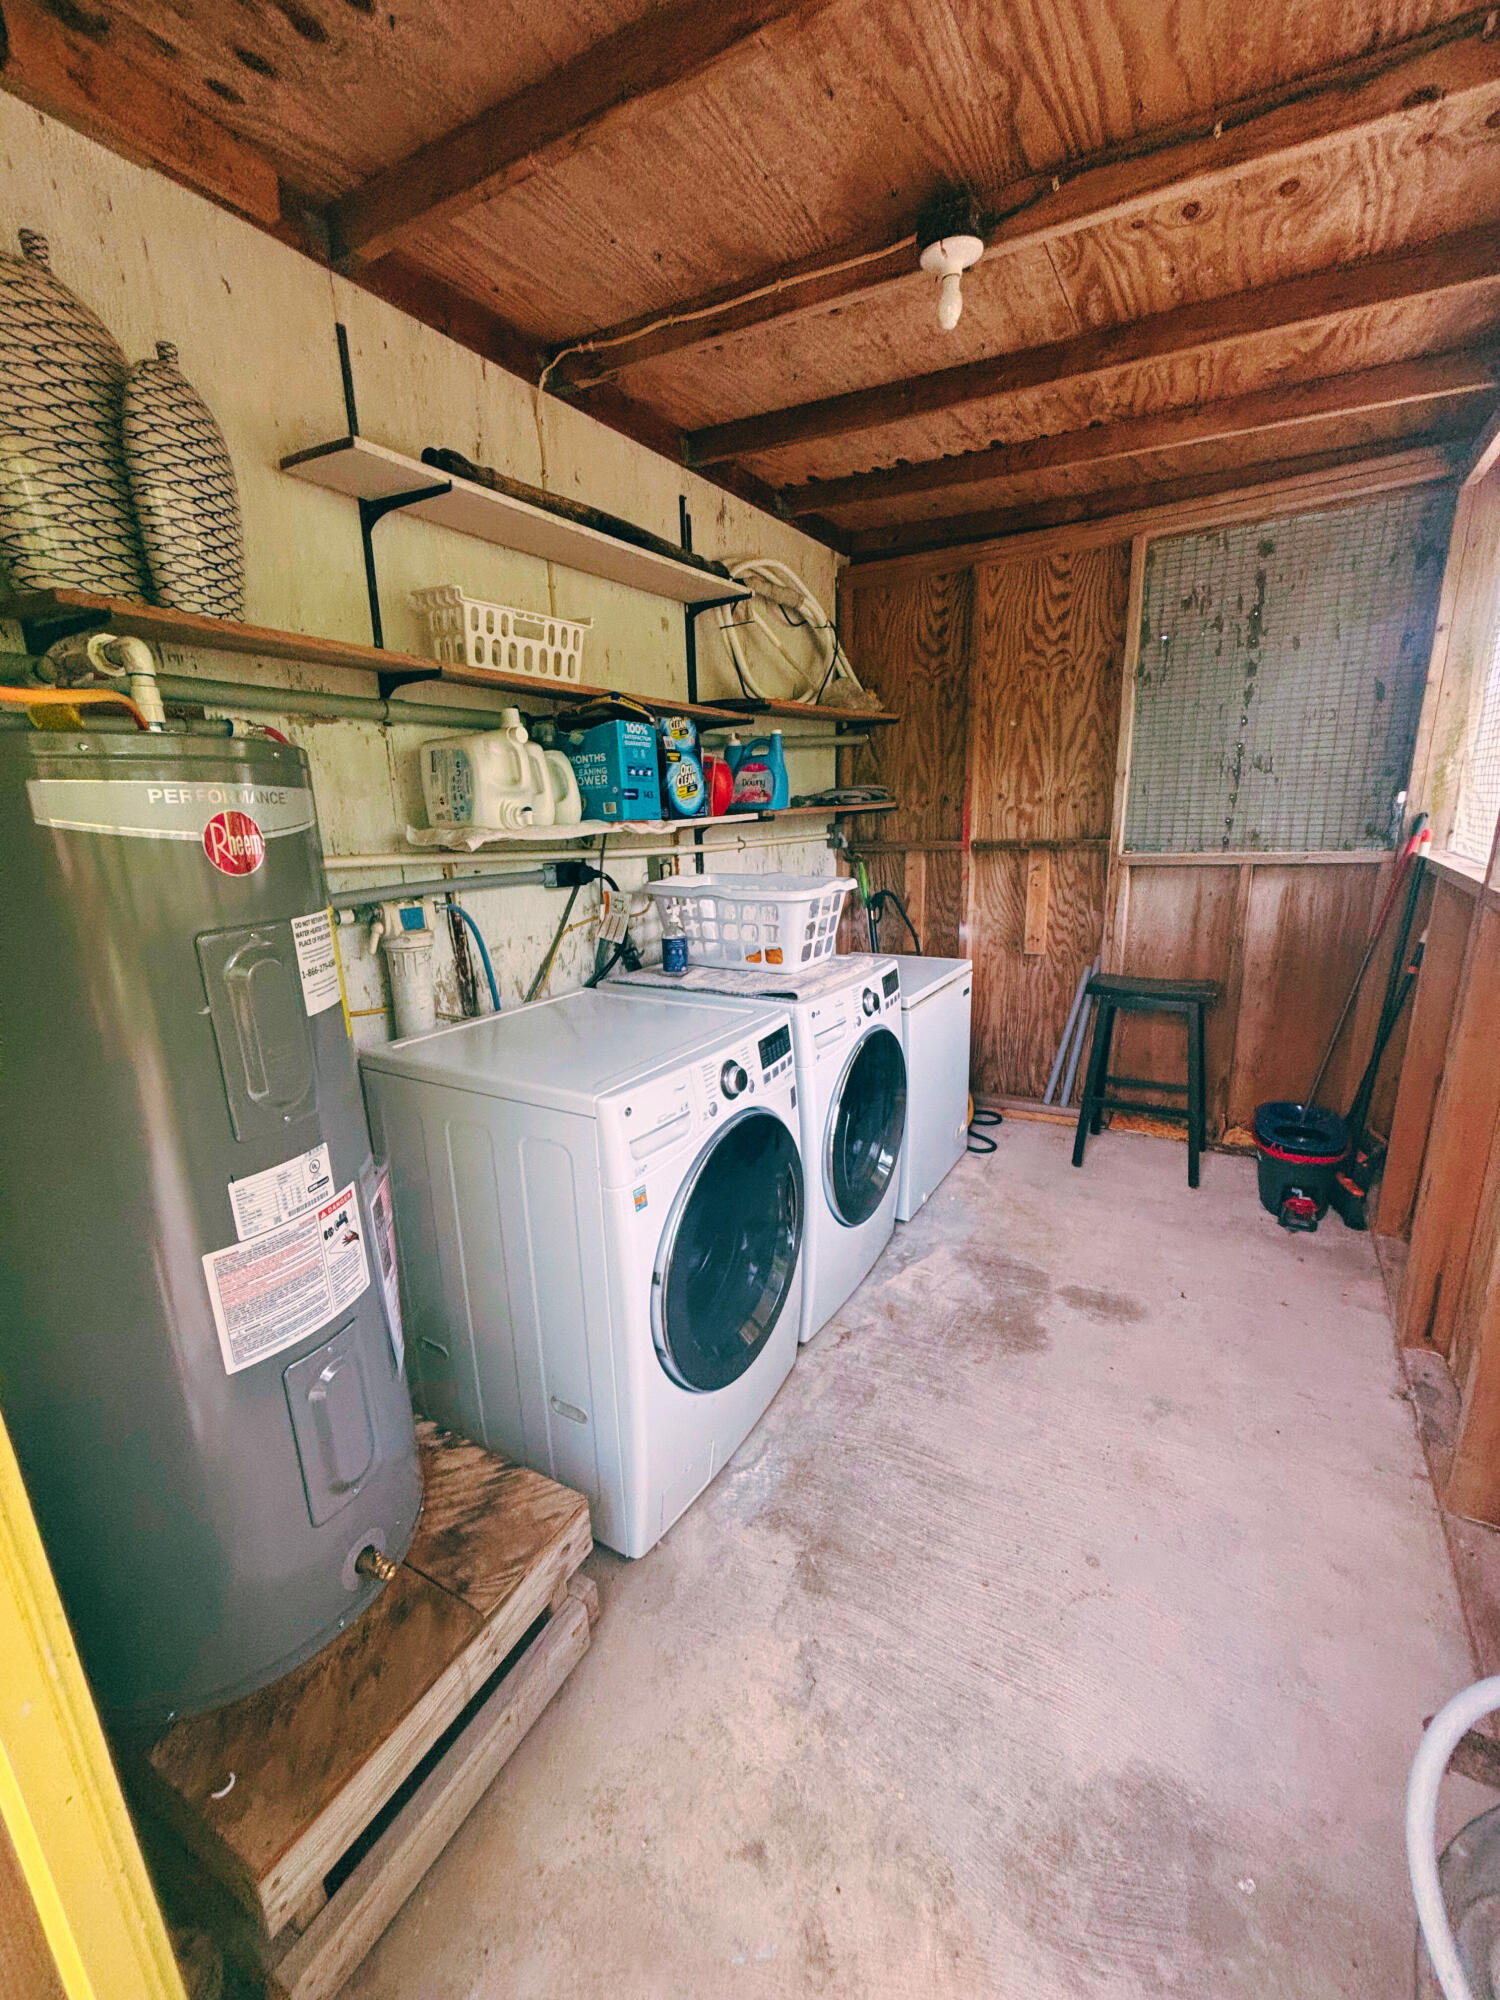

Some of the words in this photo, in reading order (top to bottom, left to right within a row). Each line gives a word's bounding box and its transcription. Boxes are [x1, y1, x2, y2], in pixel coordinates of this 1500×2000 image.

[625, 722, 648, 735] 100%
[669, 719, 686, 730] CLEAN
[577, 774, 609, 786] OWER
[676, 772, 696, 787] CLEAN
[147, 788, 286, 804] PERFORMANCE
[209, 811, 263, 865] Rheem
[298, 939, 311, 948] PLACE
[326, 1190, 352, 1215] DANGER
